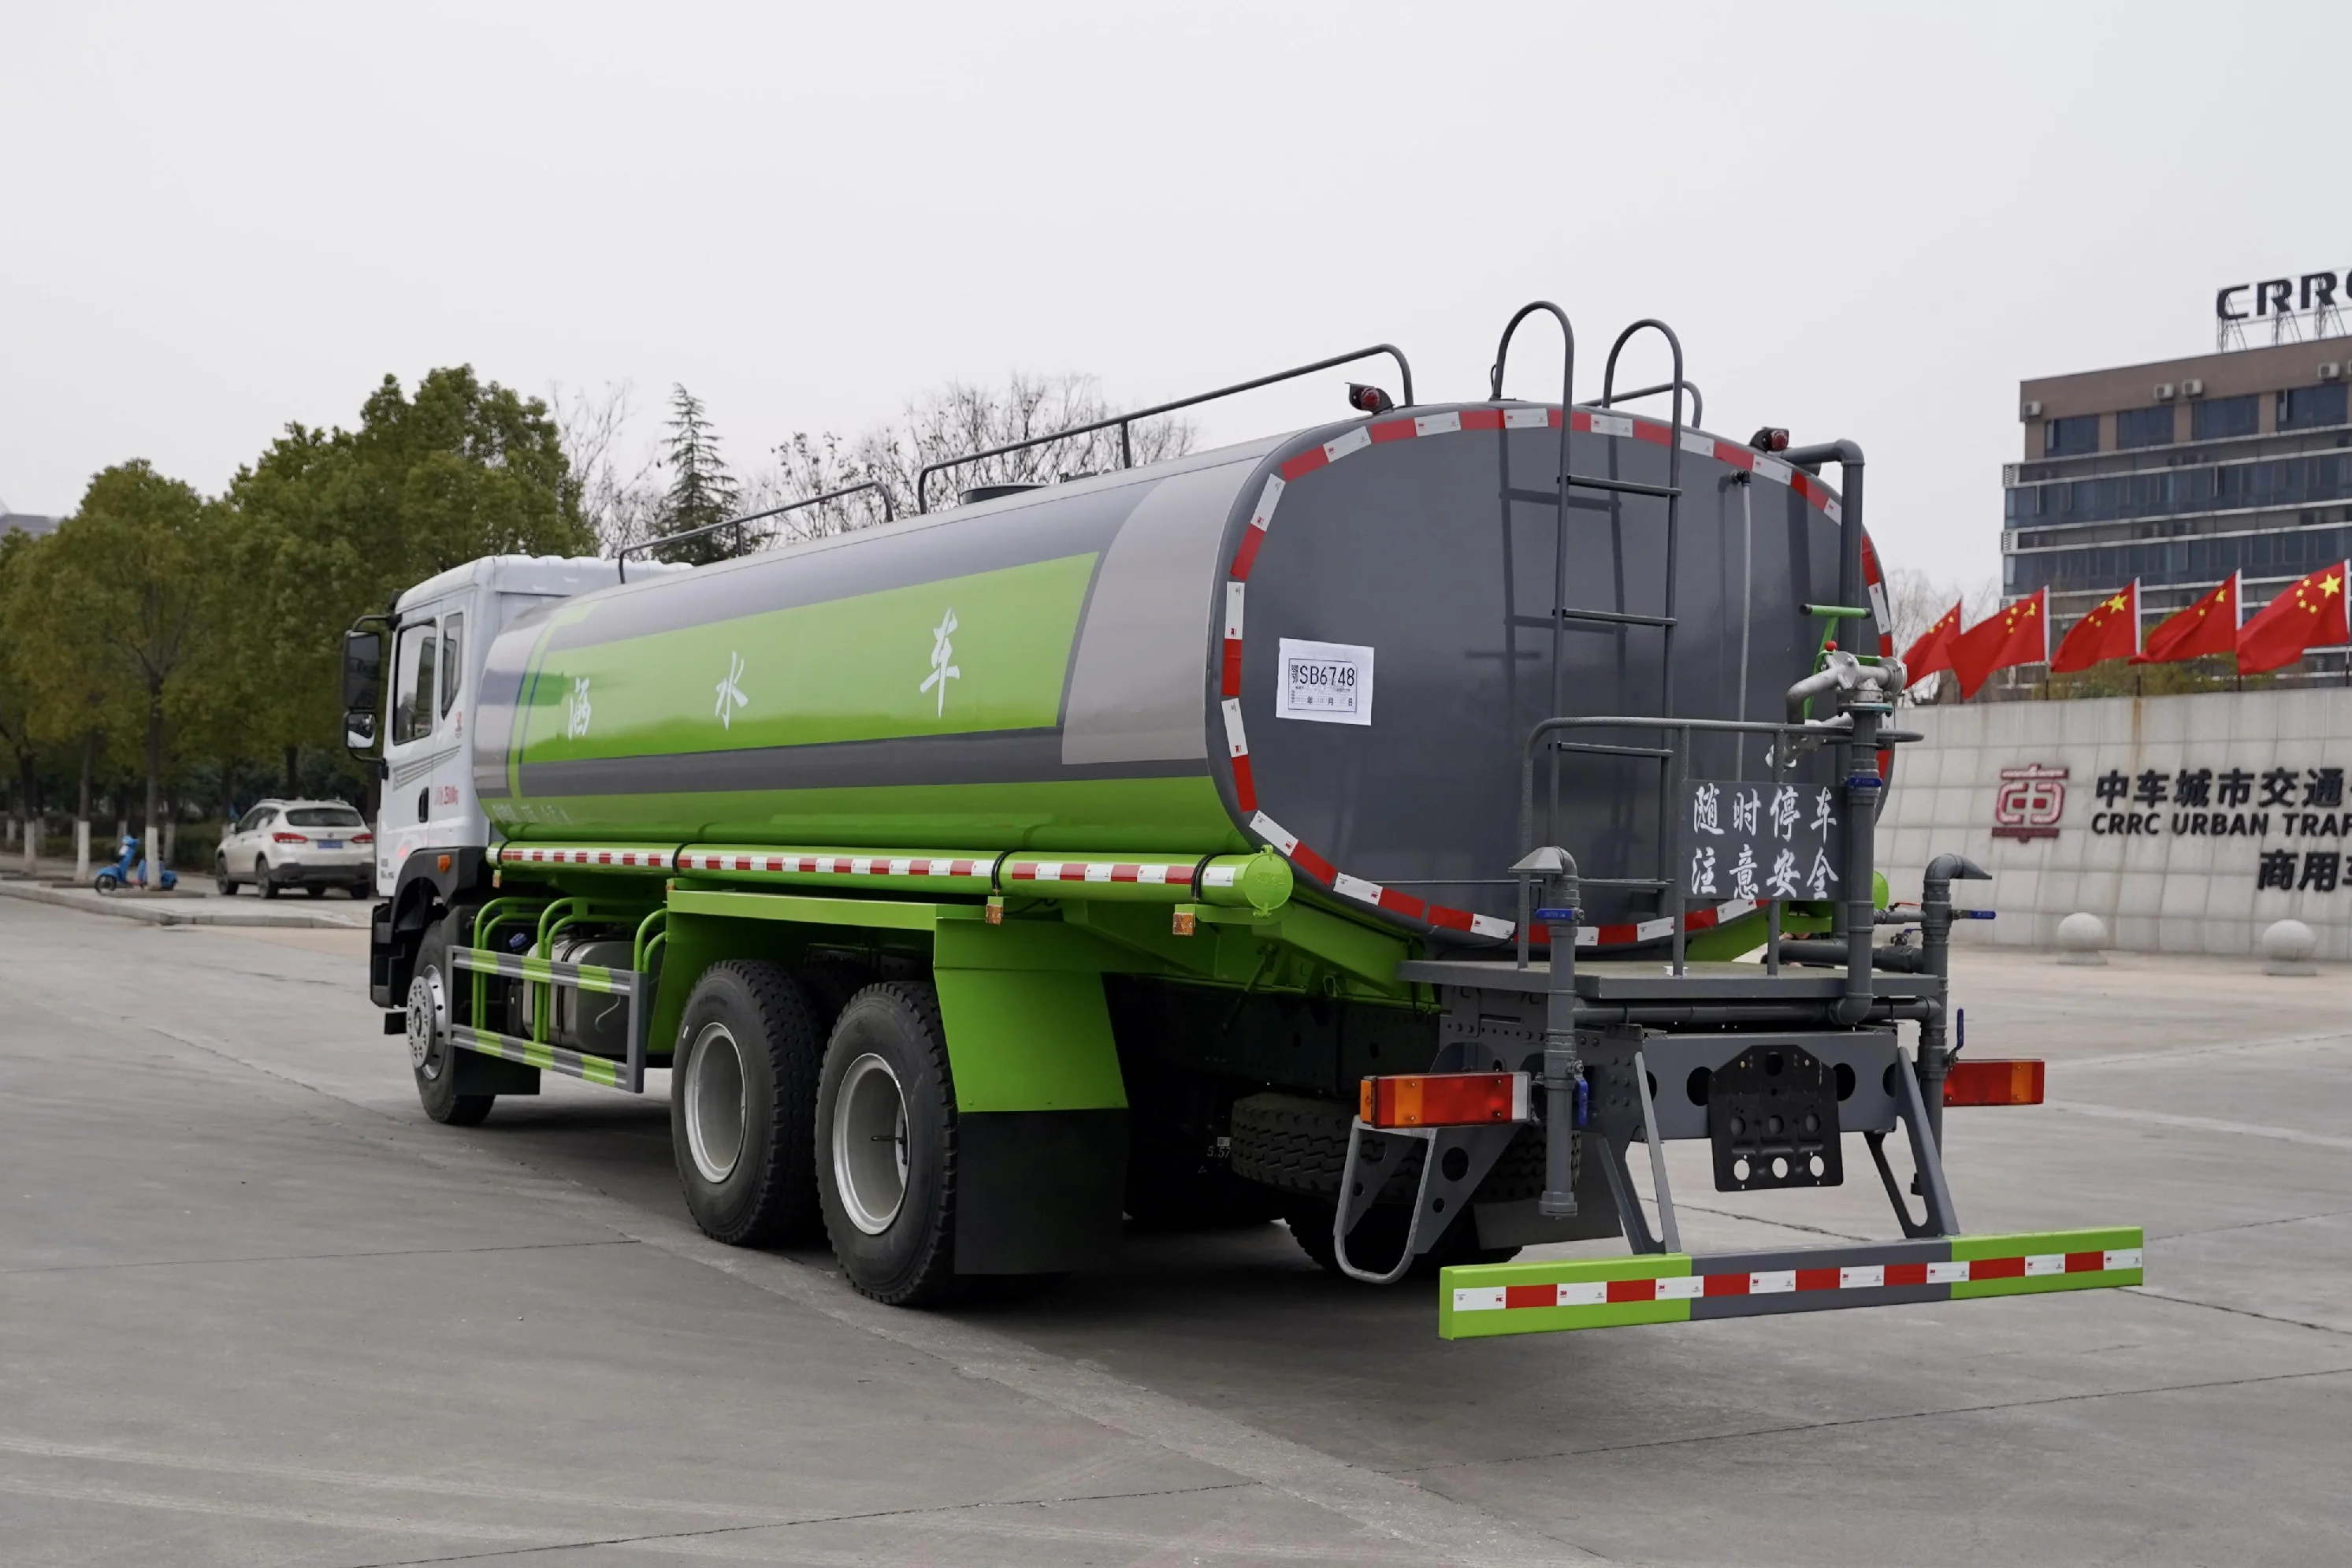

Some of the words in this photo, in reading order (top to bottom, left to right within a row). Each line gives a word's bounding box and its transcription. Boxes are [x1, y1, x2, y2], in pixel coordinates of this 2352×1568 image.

[2216, 268, 2352, 320] CRR
[2095, 767, 2352, 809] 中车城市交通
[1694, 782, 1837, 843] 随时停车
[2090, 812, 2161, 835] CRRC
[2172, 812, 2269, 836] URBAN
[1692, 844, 1839, 900] 注意安全
[2257, 849, 2352, 891] 商用
